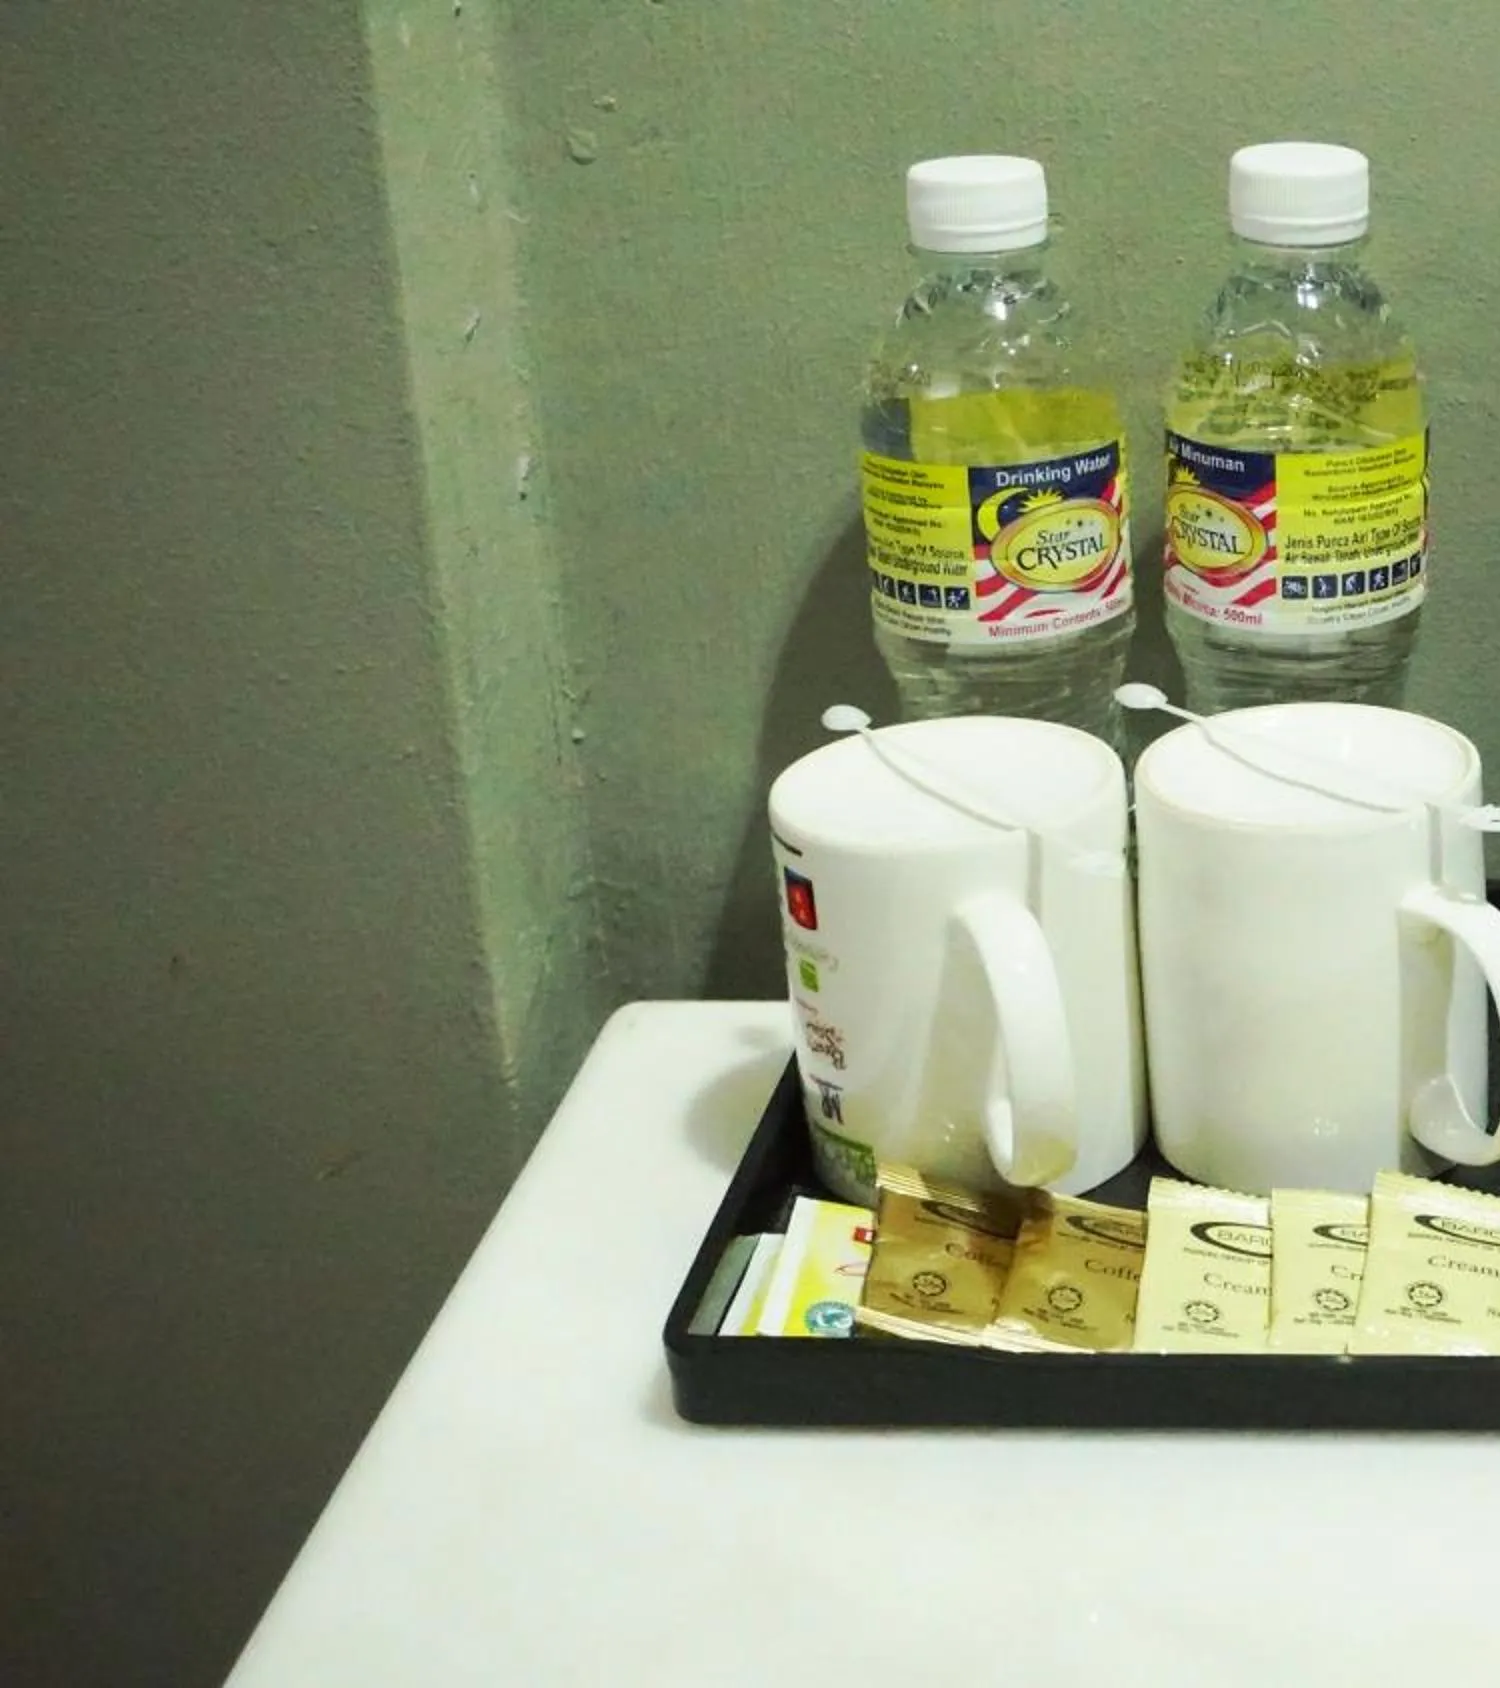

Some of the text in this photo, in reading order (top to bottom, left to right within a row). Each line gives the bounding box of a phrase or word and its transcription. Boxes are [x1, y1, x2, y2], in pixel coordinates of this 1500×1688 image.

[995, 453, 1110, 487] Drinking Water
[1181, 442, 1246, 473] Minuman
[1036, 529, 1070, 546] Star
[1016, 533, 1107, 571] CRYSTAL
[1223, 604, 1263, 627] 500ml
[988, 622, 1049, 638] Minimum
